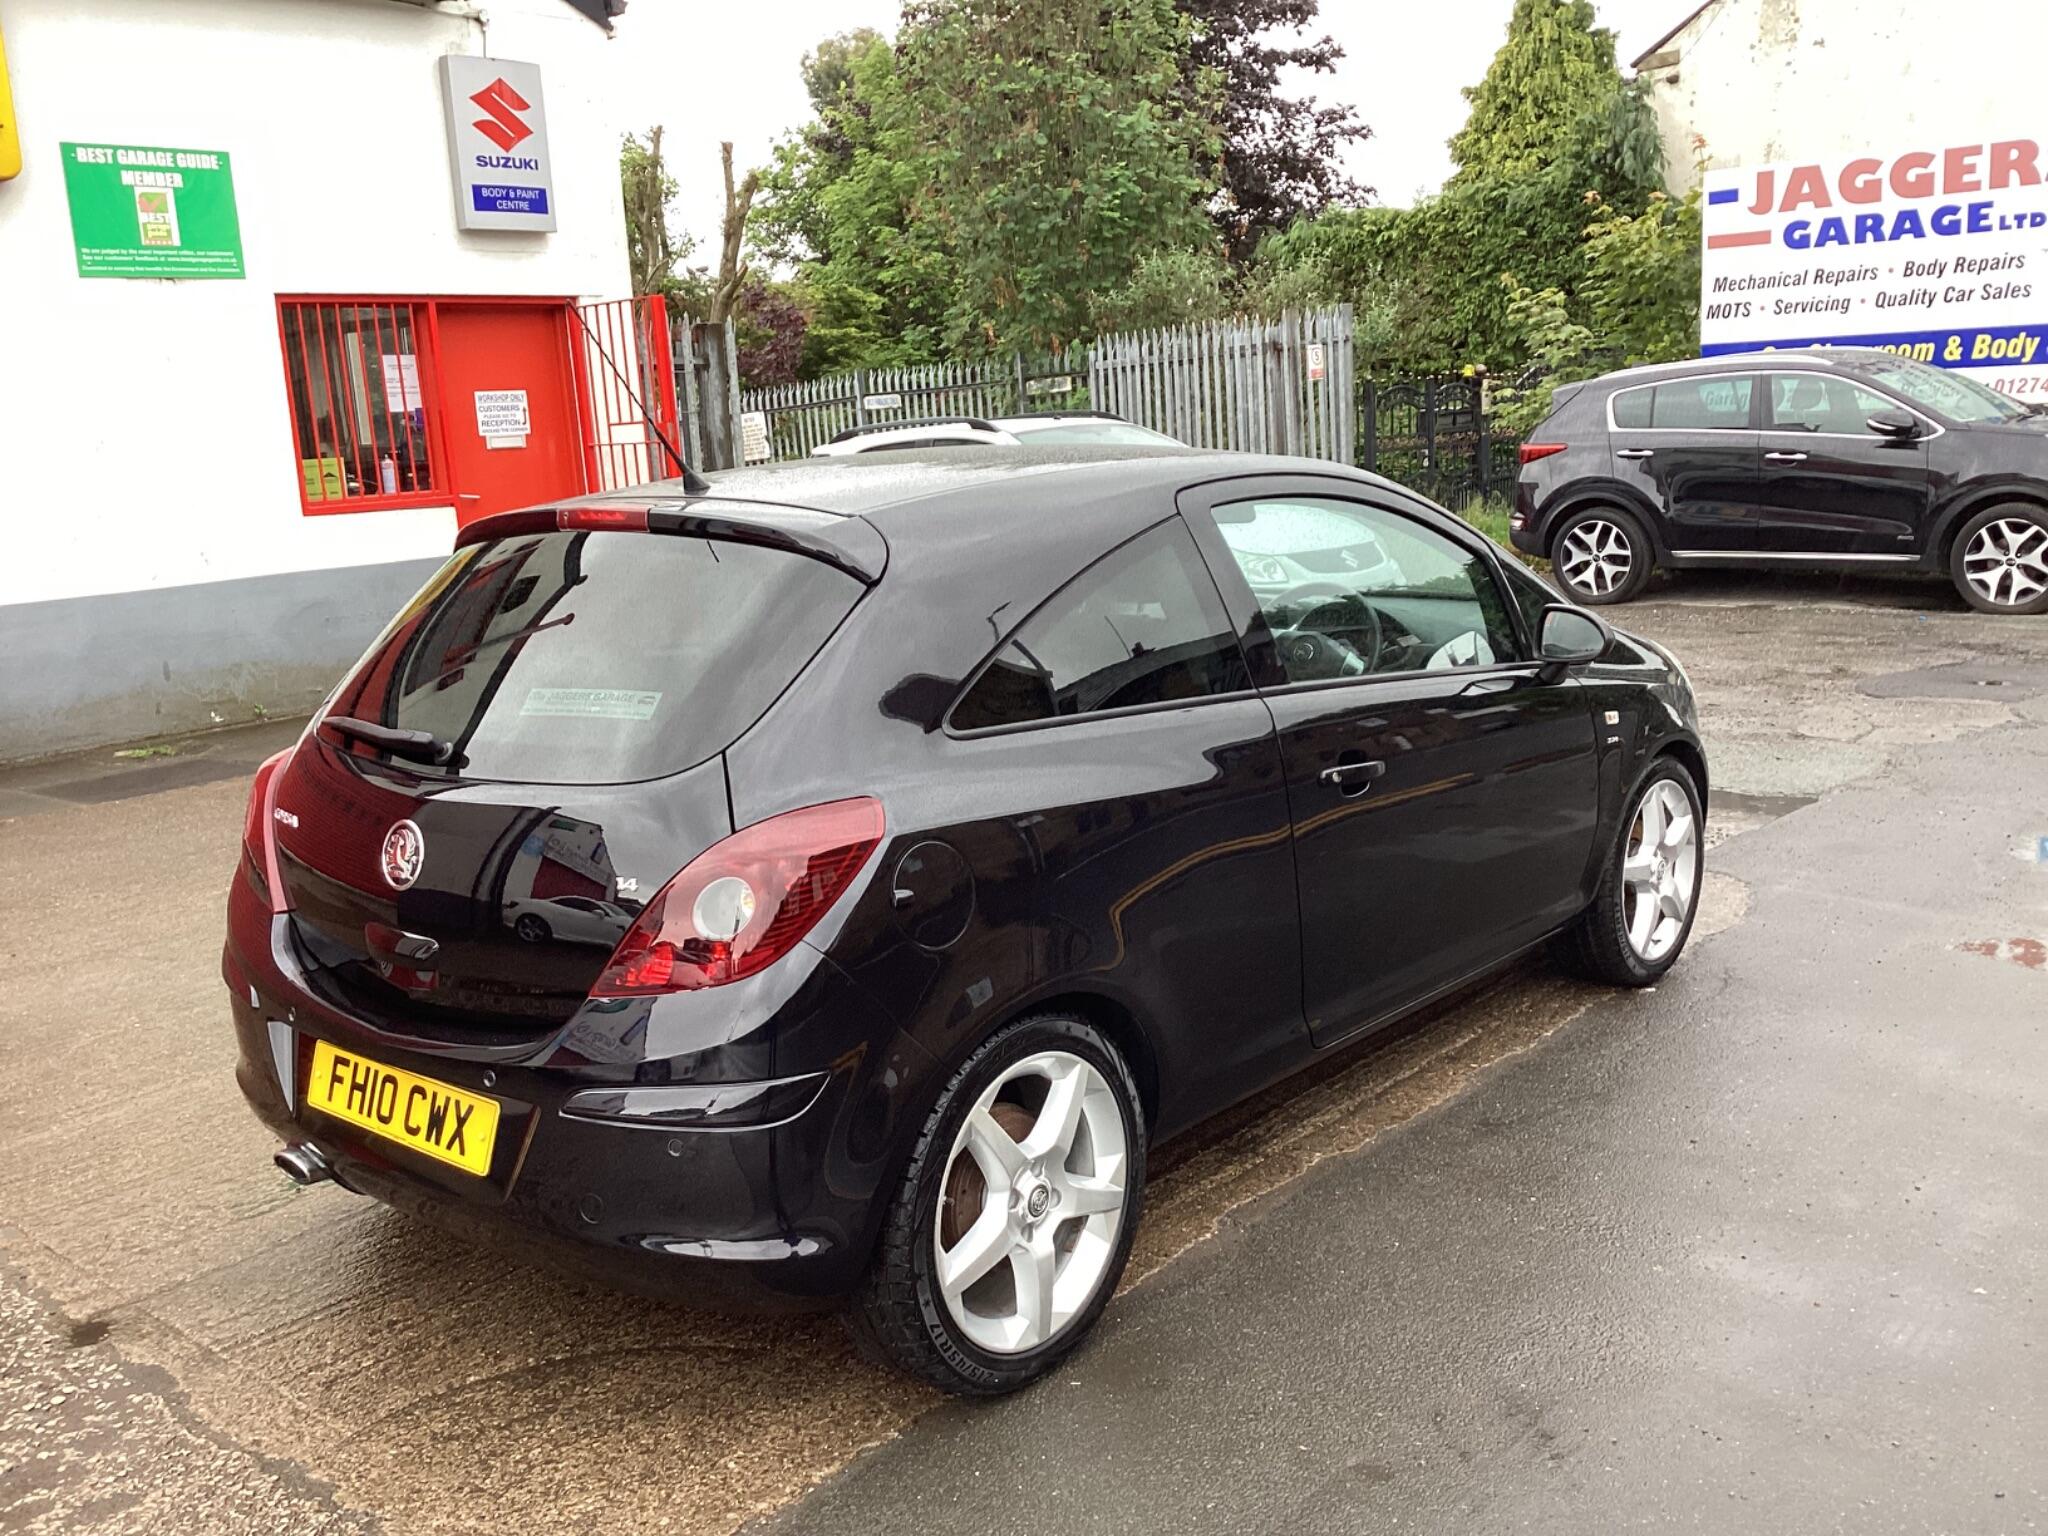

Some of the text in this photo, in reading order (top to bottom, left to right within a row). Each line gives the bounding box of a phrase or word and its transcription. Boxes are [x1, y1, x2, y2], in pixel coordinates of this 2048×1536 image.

[76, 147, 220, 170] BEST GARAGE GUIDE
[475, 155, 539, 171] SUZUKI
[120, 170, 184, 188] MEMBER
[1747, 139, 2048, 215] JAGGER
[481, 187, 540, 199] BODY & PAINT
[496, 200, 530, 210] CENTRE
[1783, 200, 2047, 249] GARAGE LTD
[1712, 252, 2026, 293] Mechanical Repairs Body Repairs
[1706, 282, 2032, 320] MOTS Servicing Quality Car Sales
[1943, 335, 1963, 361] &
[1971, 331, 2041, 363] Body
[478, 404, 520, 412] CUSTOMERS
[481, 419, 521, 427] RECEPTION
[327, 1054, 475, 1157] FH10 CWX
